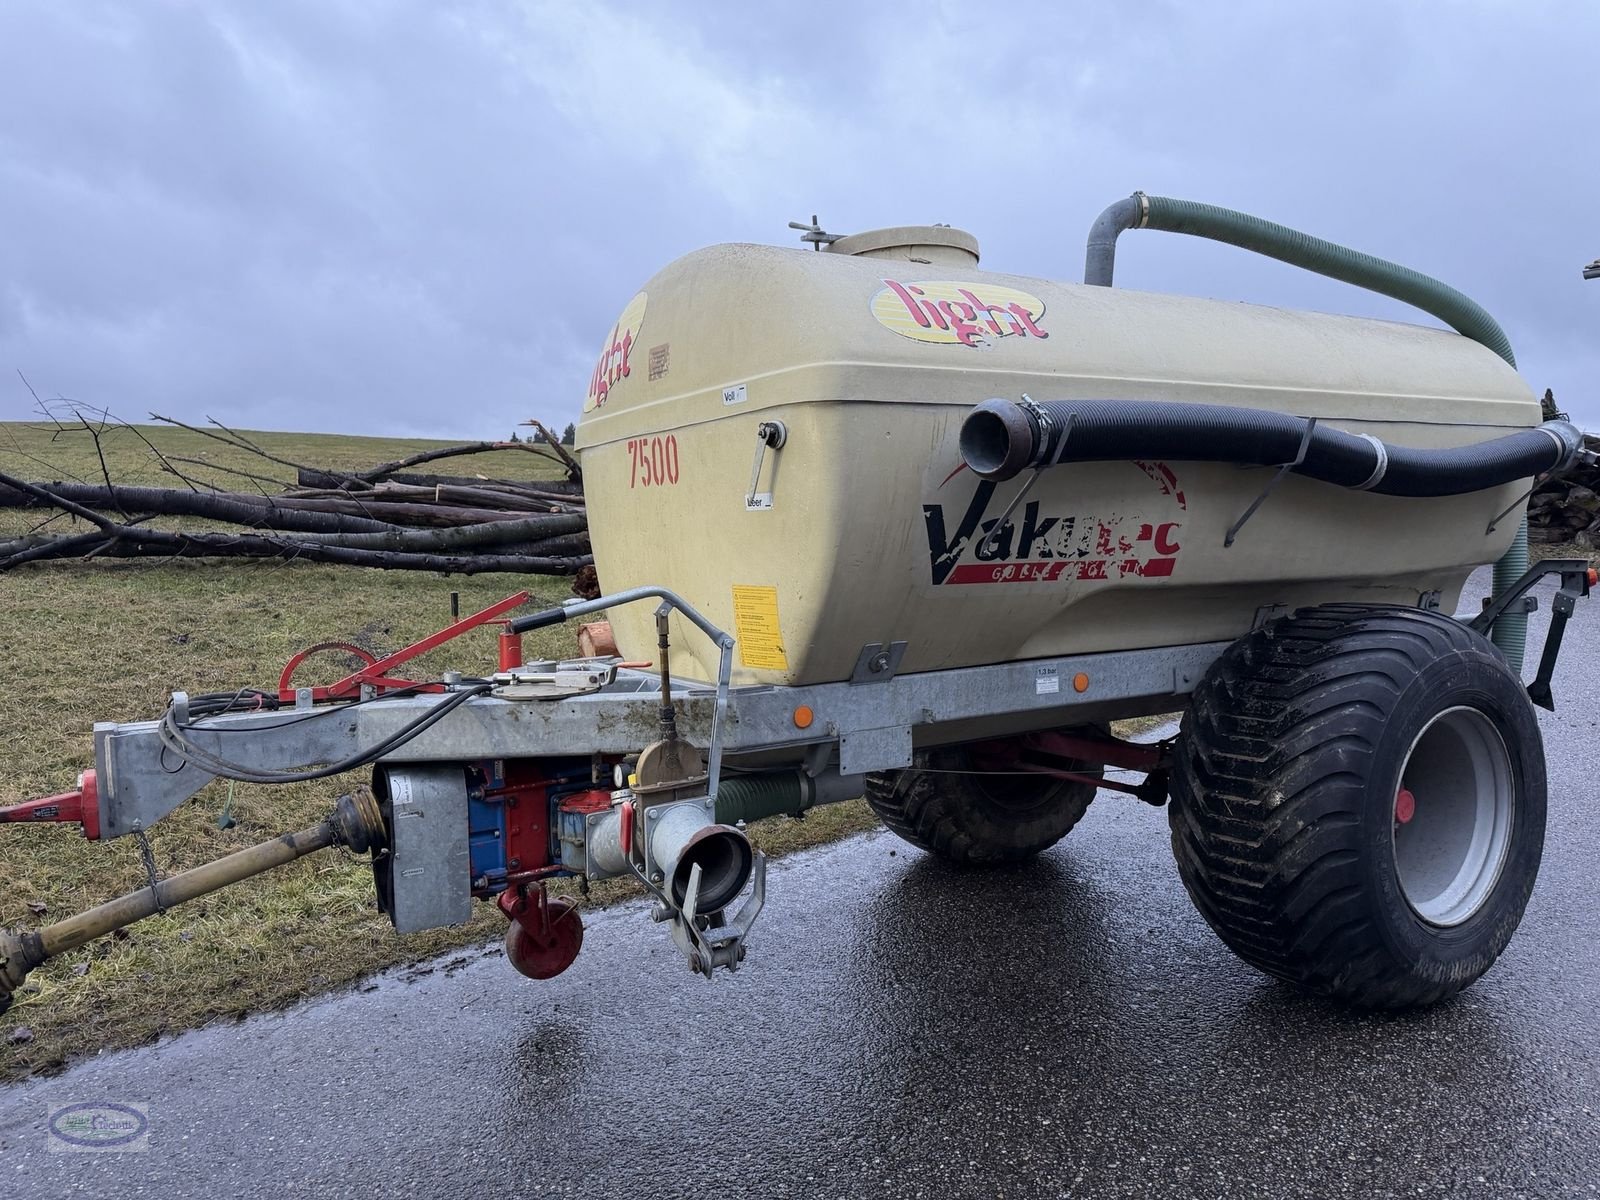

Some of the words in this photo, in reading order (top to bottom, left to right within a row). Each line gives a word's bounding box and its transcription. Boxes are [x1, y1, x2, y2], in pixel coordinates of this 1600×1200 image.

[881, 278, 1050, 347] light
[724, 391, 736, 402] Voll
[628, 434, 679, 488] 7500
[747, 497, 762, 508] Leer
[1047, 667, 1057, 675] bar
